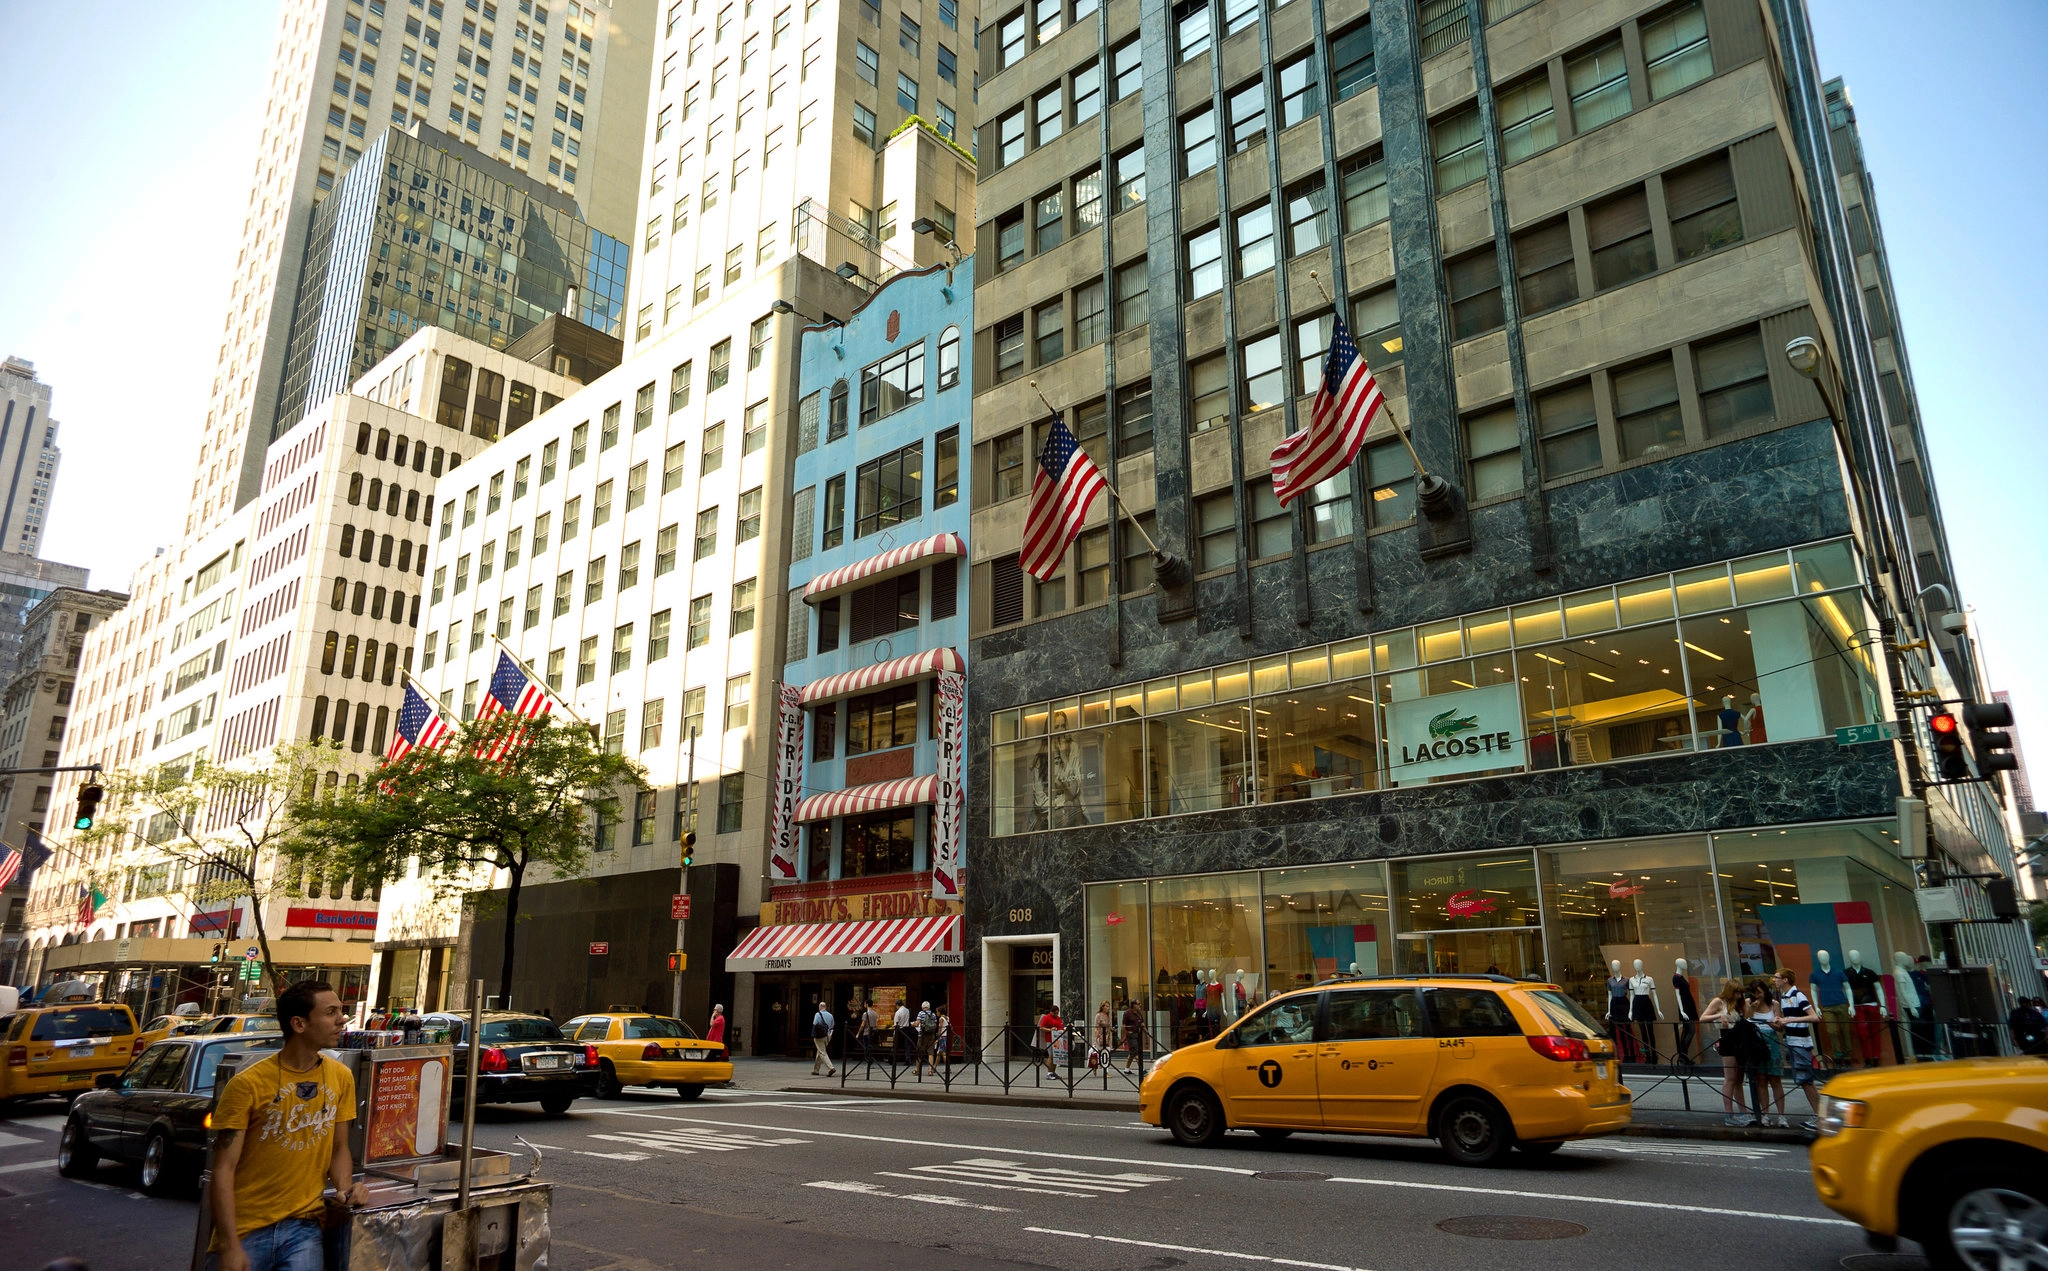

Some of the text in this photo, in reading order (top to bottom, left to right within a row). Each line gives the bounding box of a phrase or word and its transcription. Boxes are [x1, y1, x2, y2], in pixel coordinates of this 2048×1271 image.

[1847, 729, 1859, 742] 5
[1402, 731, 1512, 764] LACOSTE
[315, 913, 377, 925] Bank of Am
[1009, 908, 1032, 922] 608
[380, 1066, 405, 1075] HOT DOG
[392, 1074, 418, 1083] SAUSAGE
[378, 1084, 406, 1093] CHILI DOG
[389, 1102, 407, 1110] KNISH
[373, 1148, 403, 1157] GATORADE
